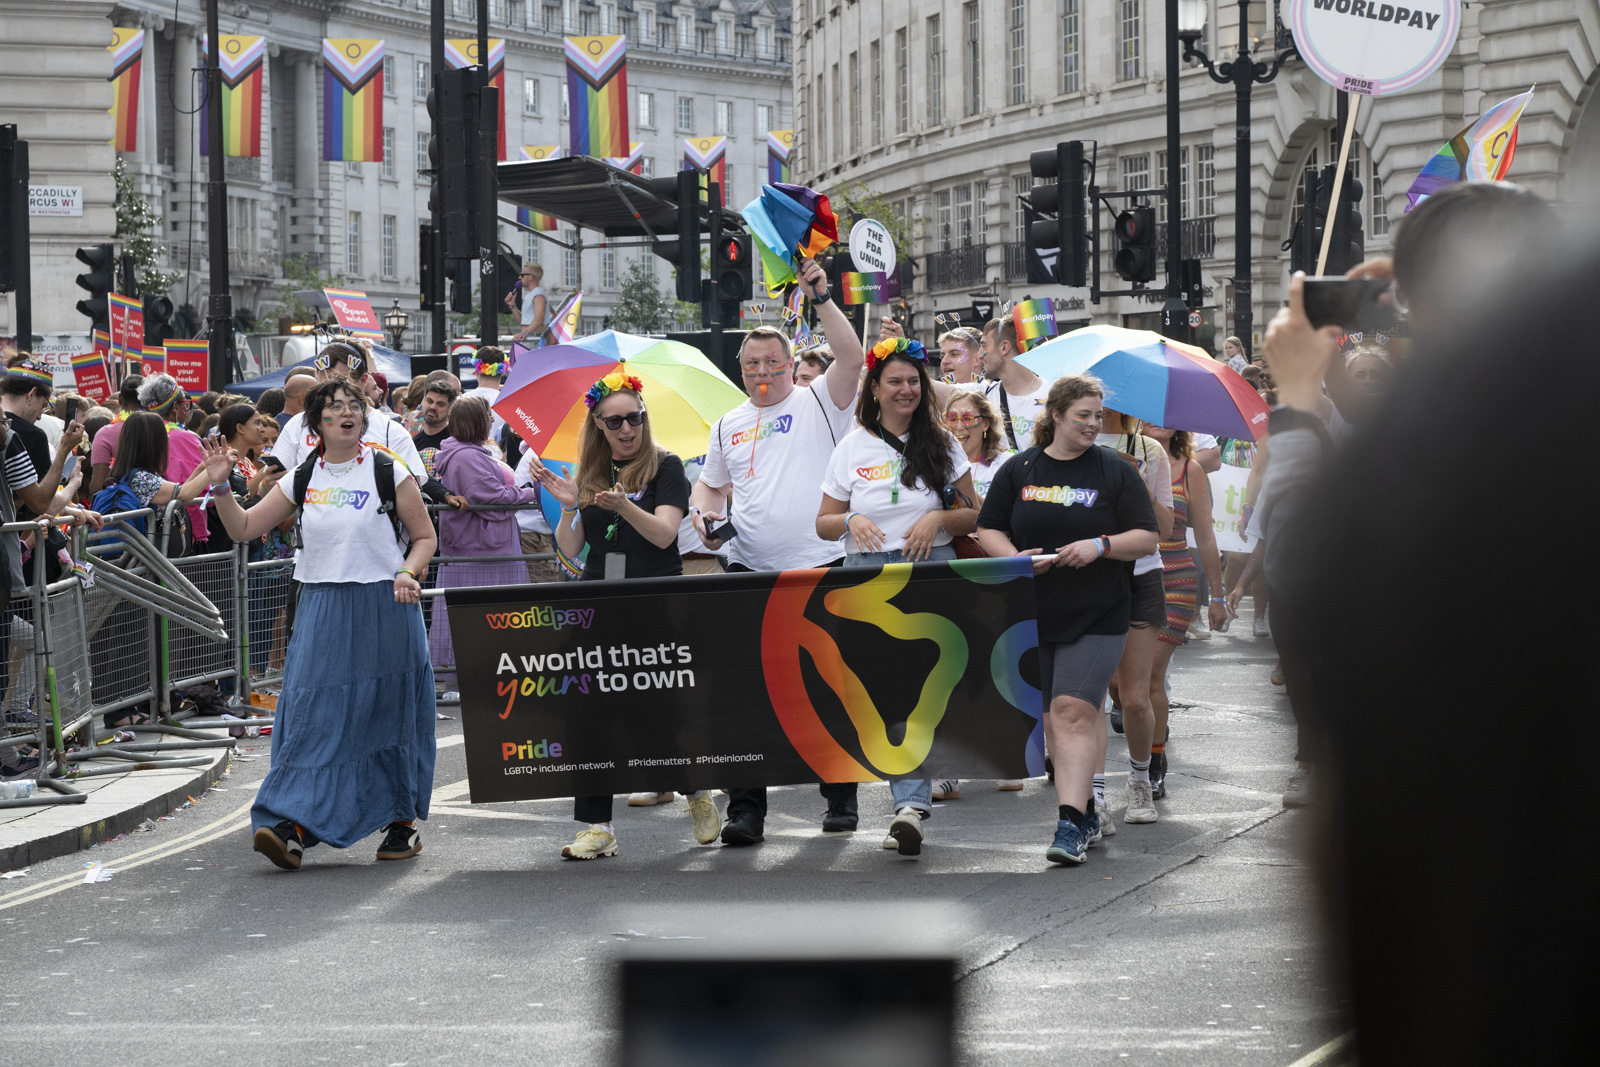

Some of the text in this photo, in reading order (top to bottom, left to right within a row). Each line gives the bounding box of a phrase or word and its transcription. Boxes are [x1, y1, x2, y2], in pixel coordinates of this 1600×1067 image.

[1314, 0, 1441, 31] WORLDPAY
[29, 188, 77, 198] CCADILLY
[30, 198, 74, 207] RCUS W1
[867, 227, 883, 243] THE
[866, 241, 882, 256] FDA
[860, 250, 886, 271] UNION
[113, 313, 124, 321] Your
[342, 307, 366, 316] Open
[346, 315, 370, 324] wide!
[1021, 313, 1054, 324] worldpay
[515, 407, 541, 435] worldpay
[732, 416, 792, 446] worlday
[1023, 486, 1097, 506] worldpay
[486, 606, 594, 630] worldpay
[497, 642, 692, 675] A world that's
[497, 668, 695, 720] yours to own
[502, 739, 562, 760] Pride
[504, 760, 615, 776] LGBTQ+ inclusion network
[628, 753, 764, 768] #Pridematters #Prideinlondon
